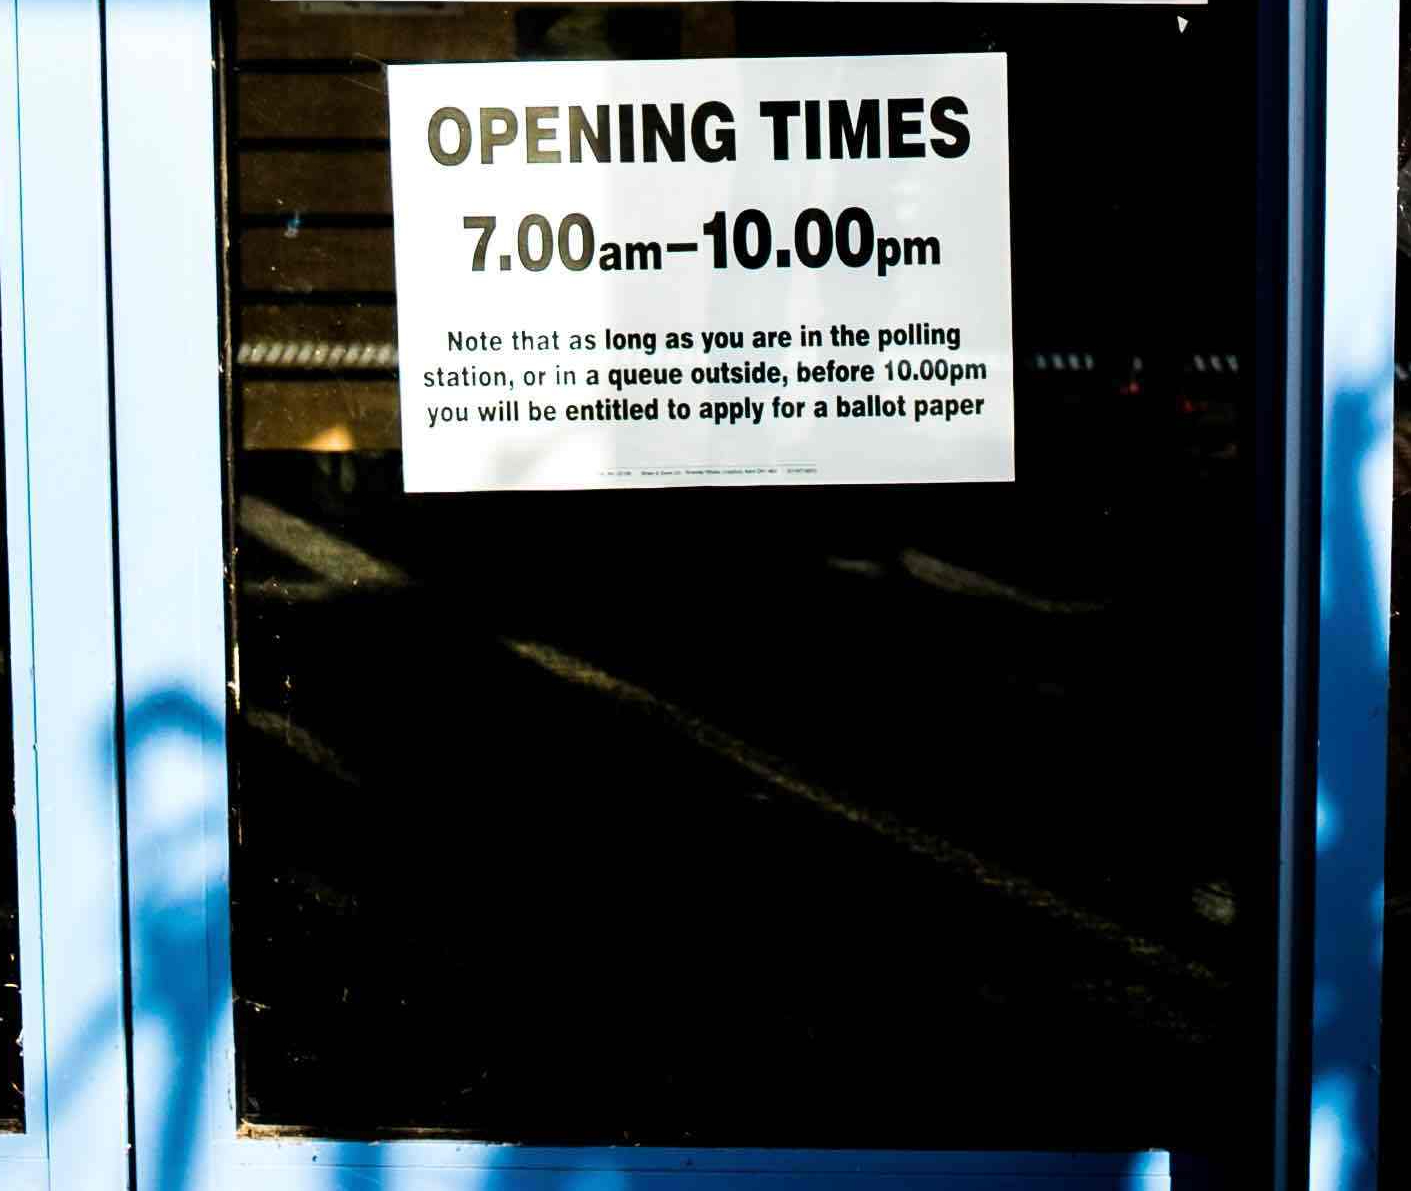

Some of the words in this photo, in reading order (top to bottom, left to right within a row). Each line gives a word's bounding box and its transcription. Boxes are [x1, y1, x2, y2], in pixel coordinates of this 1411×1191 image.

[428, 101, 736, 166] OPENING
[760, 96, 970, 162] TIMES
[448, 331, 502, 352] Note
[511, 331, 560, 351] that
[605, 329, 656, 354] long
[702, 330, 744, 353] you
[753, 329, 792, 348] are
[879, 326, 961, 350] polling
[424, 367, 514, 391] station,
[608, 368, 682, 390] queue
[691, 365, 788, 388] outside,
[797, 364, 874, 382] before
[885, 360, 986, 387] 10.00pm
[428, 405, 468, 428] you
[479, 402, 520, 422] will
[529, 402, 557, 422] be
[566, 401, 658, 421] entitled
[668, 402, 690, 420] to
[699, 401, 764, 424] apply
[772, 398, 805, 419] for
[814, 400, 827, 418] a
[836, 397, 906, 418] ballot
[915, 398, 984, 422] paper
